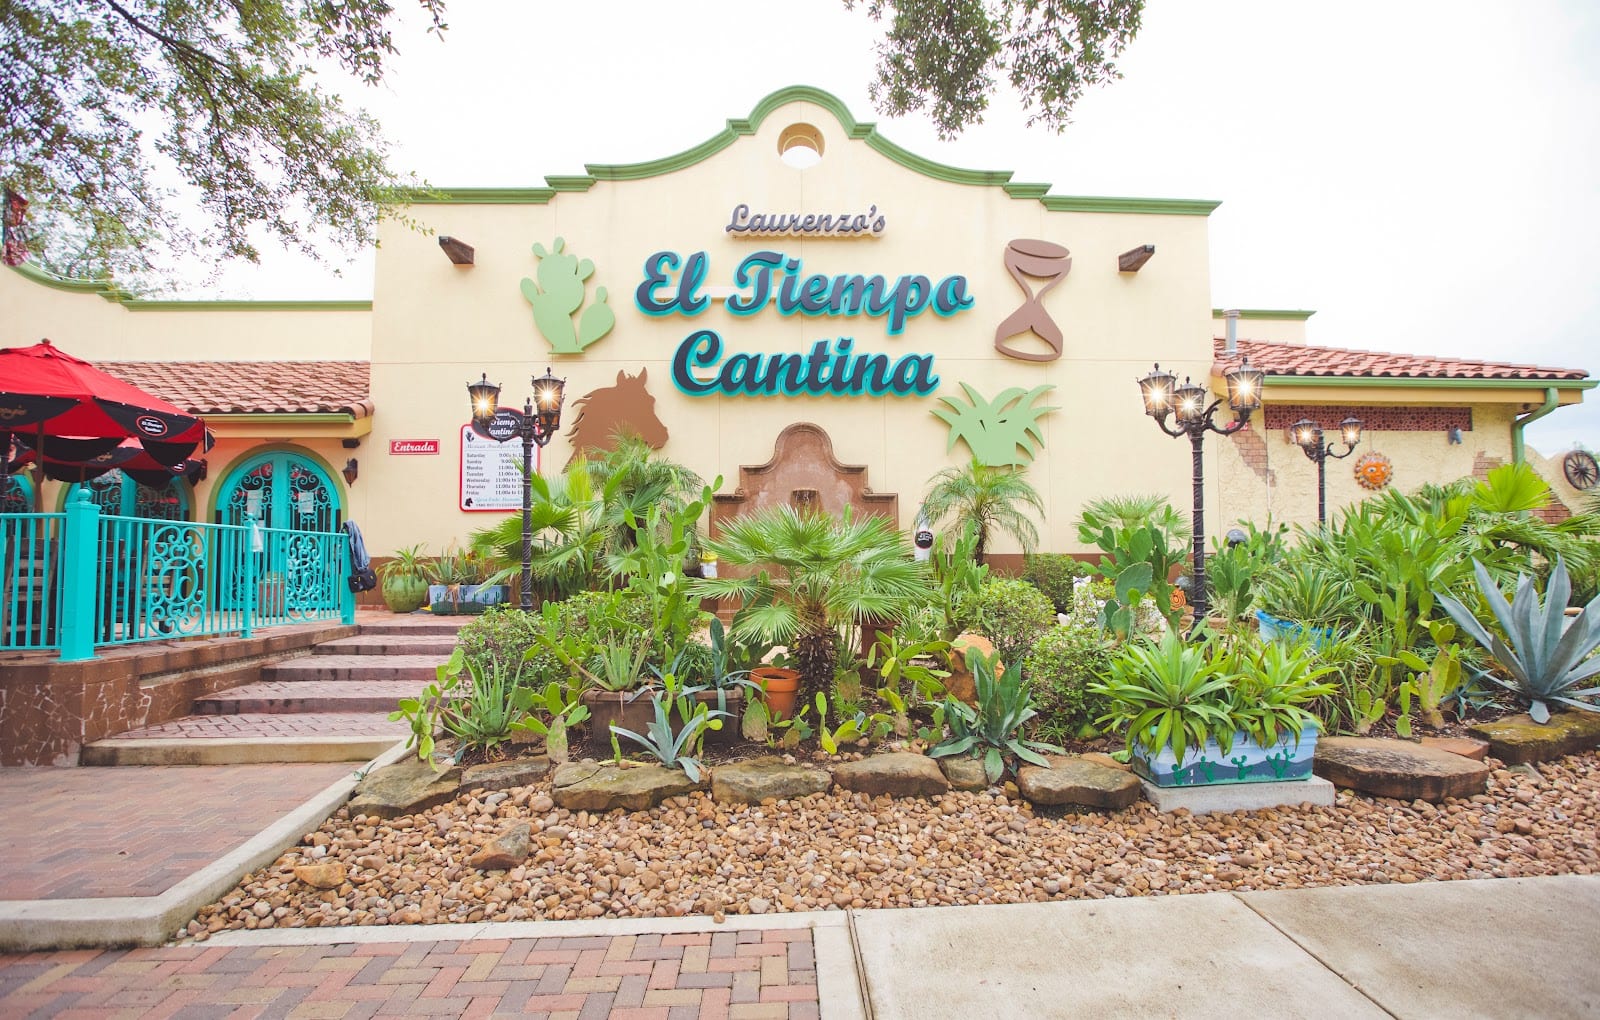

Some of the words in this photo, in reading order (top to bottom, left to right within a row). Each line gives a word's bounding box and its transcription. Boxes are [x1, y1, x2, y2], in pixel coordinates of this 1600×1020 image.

[725, 203, 887, 236] Laurenzo's
[634, 249, 712, 317] El
[726, 249, 975, 334] Tiempo
[671, 329, 941, 396] Cantina
[394, 441, 435, 452] Entrada
[489, 427, 514, 435] antin
